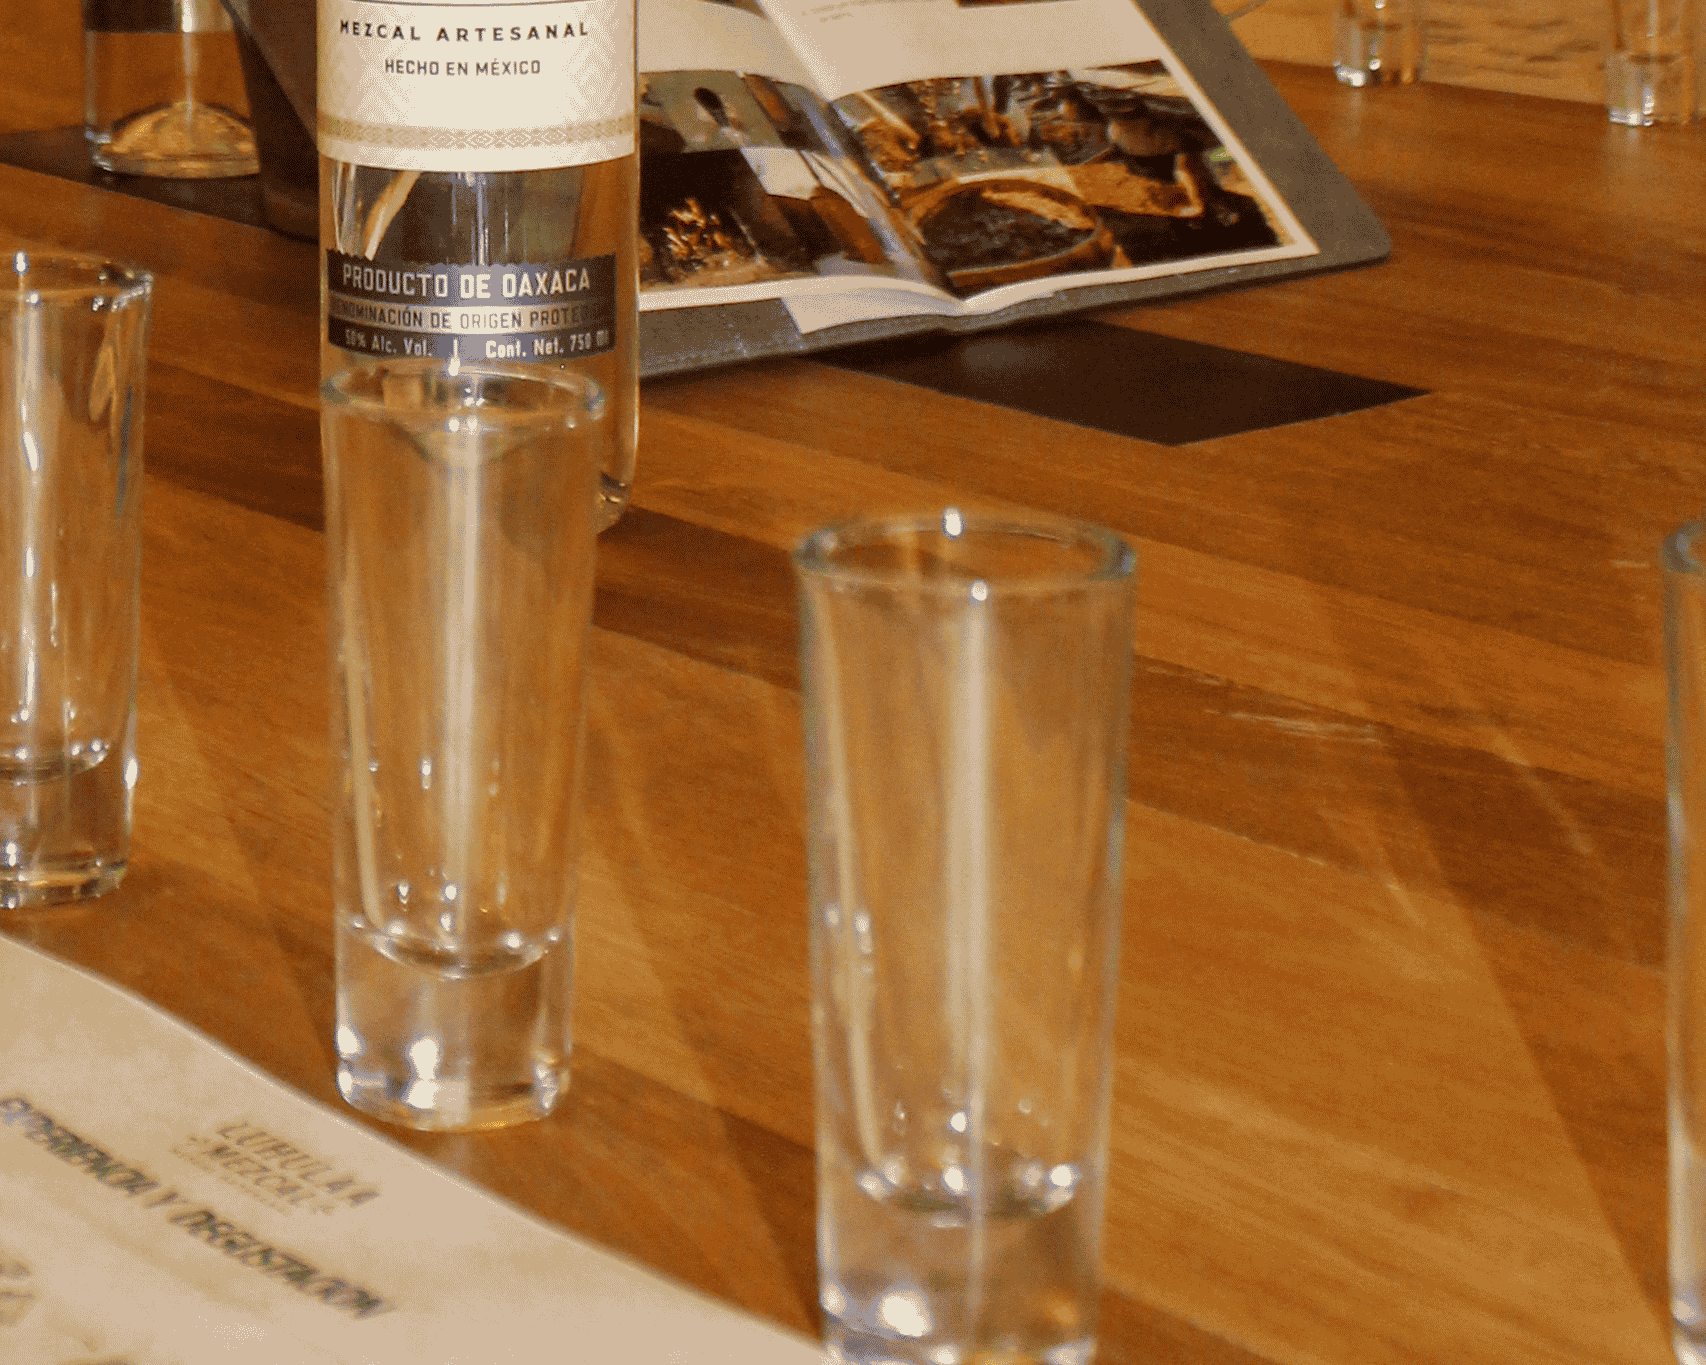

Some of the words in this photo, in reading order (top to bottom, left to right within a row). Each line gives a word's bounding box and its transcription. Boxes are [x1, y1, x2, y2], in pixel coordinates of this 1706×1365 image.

[340, 18, 422, 42] MEZCAL
[436, 21, 590, 43] ARTESANAL
[384, 58, 440, 77] HECHO
[446, 60, 469, 77] EN
[475, 57, 542, 77] MÉXICO
[343, 263, 449, 299] PRODUCTO
[459, 272, 491, 300] DE
[502, 267, 591, 299] OAXACA
[430, 312, 452, 330] DE
[460, 312, 523, 331] ORIGEN
[371, 332, 398, 355] Alc.
[403, 336, 433, 357] Vol.
[485, 339, 527, 359] Cont.
[533, 337, 565, 357] Net.
